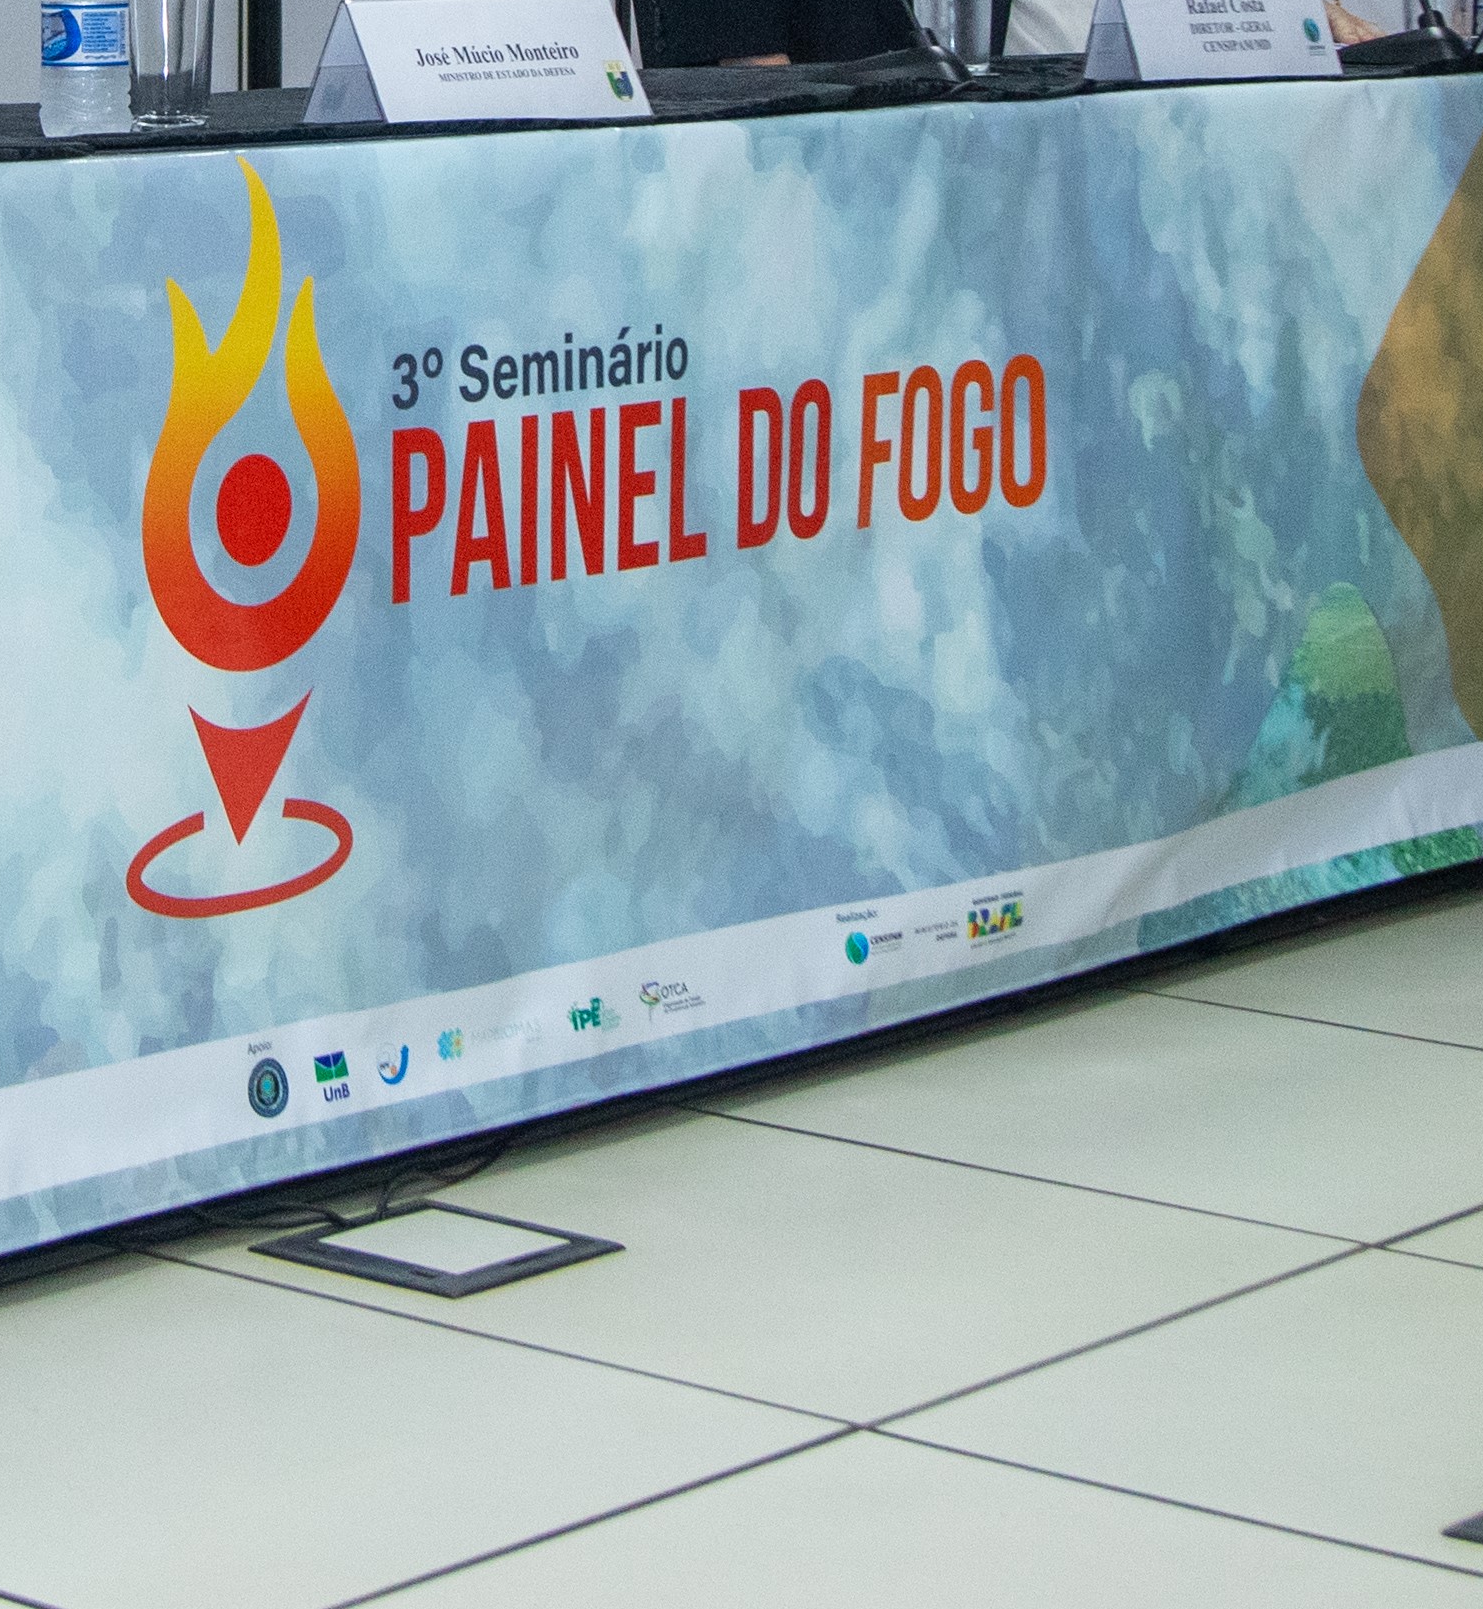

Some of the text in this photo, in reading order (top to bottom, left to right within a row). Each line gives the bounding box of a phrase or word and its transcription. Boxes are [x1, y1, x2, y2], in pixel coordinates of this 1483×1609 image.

[415, 41, 579, 67] José Múcio Monteiro
[438, 66, 576, 83] MINISTRO DE ESTADO DA DEFESA
[390, 322, 690, 412] 3º Seminário
[390, 352, 1048, 605] PAINEL DO FOGO
[323, 1082, 351, 1103] UnB
